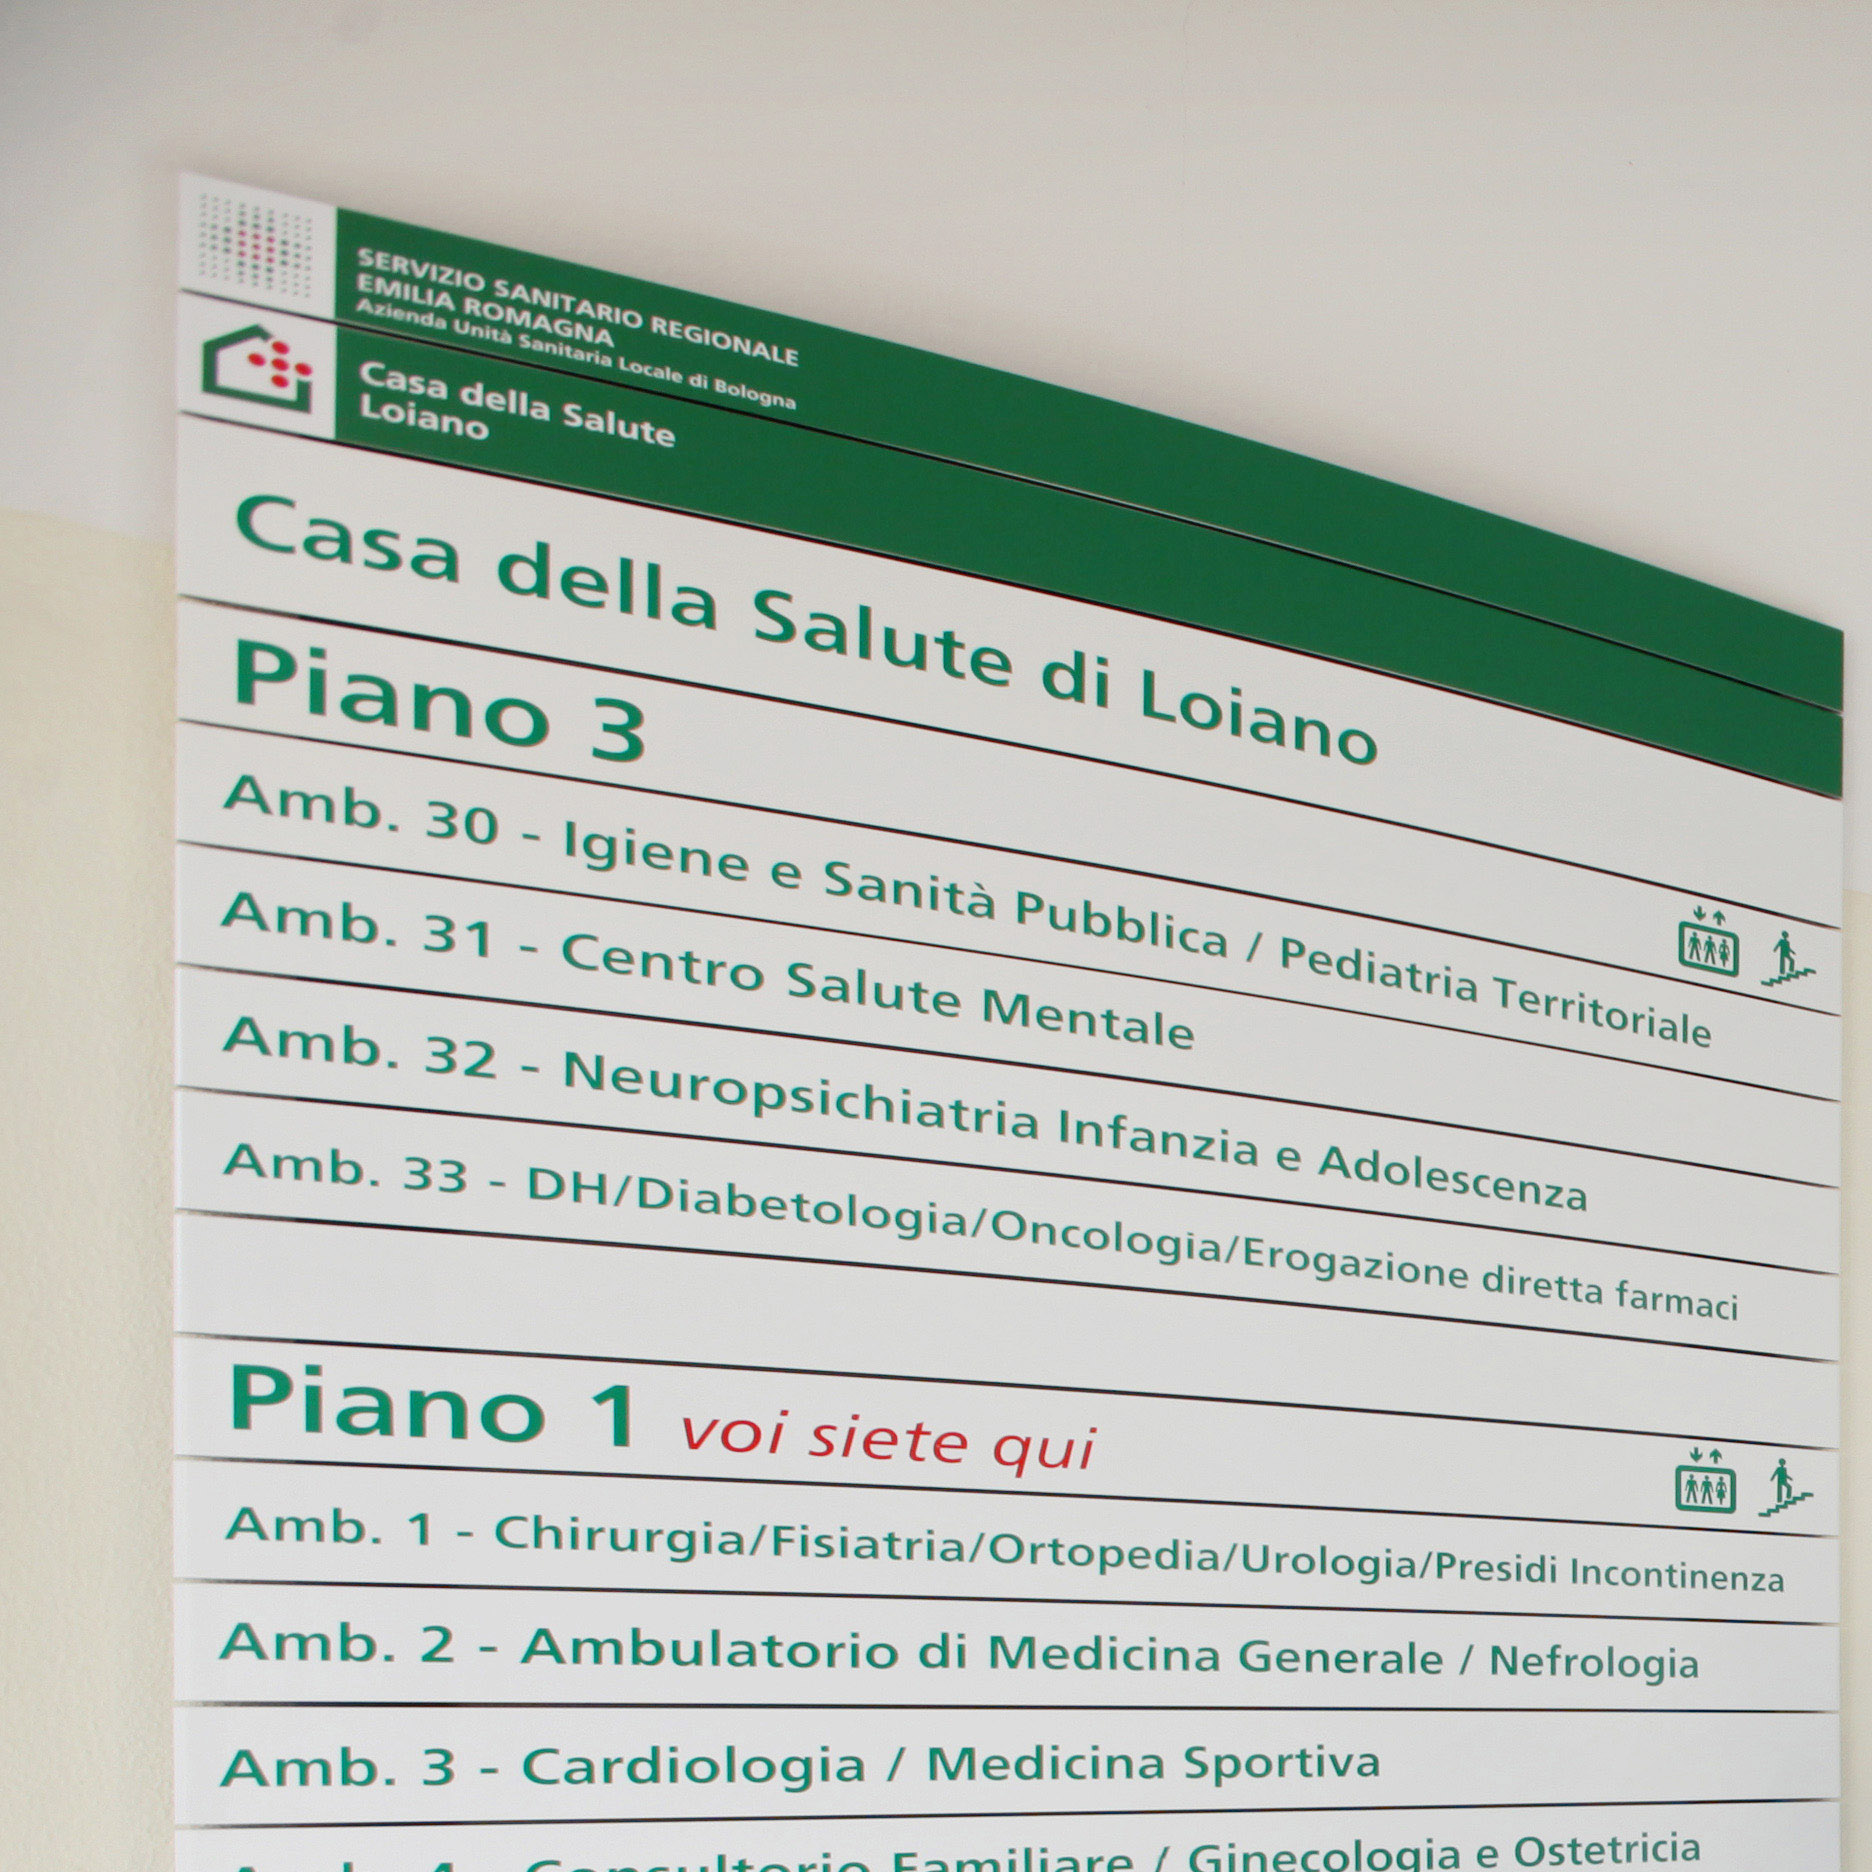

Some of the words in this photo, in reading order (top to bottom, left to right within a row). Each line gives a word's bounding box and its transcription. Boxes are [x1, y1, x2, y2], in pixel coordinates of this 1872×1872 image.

[357, 298, 447, 334] Azienda
[455, 316, 512, 345] Unità
[518, 333, 610, 366] Sanitaria
[619, 354, 684, 384] Locale
[689, 372, 708, 391] di
[715, 376, 796, 410] Bologna
[359, 248, 486, 293] SERVIZIO
[495, 279, 644, 329] SANITARIO
[652, 313, 798, 367] REGIONALE
[359, 274, 455, 314] EMILIA
[464, 298, 614, 348] ROMAGNA
[360, 360, 447, 402] Casa
[460, 380, 551, 421] della
[563, 402, 676, 448] Salute
[360, 393, 489, 440] Loiano
[233, 493, 457, 582] Casa
[495, 539, 714, 629] della
[752, 587, 1010, 686] Salute
[1039, 647, 1107, 707] di
[1141, 667, 1377, 764] Loiano
[233, 637, 548, 746] Piano
[590, 696, 646, 765] 3
[218, 773, 397, 831] Amb.
[423, 798, 496, 844] 30
[562, 819, 747, 881] Igiene
[768, 860, 800, 888] e
[822, 859, 993, 918] Sanità
[1013, 889, 1226, 967] Pubblica
[1279, 935, 1479, 1004] Pediatria
[1491, 975, 1711, 1047] Territoriale
[220, 1141, 377, 1186] Amb.
[401, 1155, 464, 1193] 33
[526, 1165, 1467, 1290] DH/Diabetologia/Oncologia/Erogazione
[1481, 1263, 1602, 1303] diretta
[1614, 1278, 1738, 1320] farmaci
[229, 1362, 543, 1443] Piano
[588, 1383, 628, 1447] 1
[683, 1409, 789, 1454] voi
[809, 1413, 968, 1464] siete
[994, 1427, 1098, 1479] qui
[222, 1505, 379, 1545] Amb.
[405, 1511, 426, 1546] 1
[493, 1513, 1556, 1585] Chirurgia/Fisiatria/Ortopedia/Urologia/Presidi
[1569, 1557, 1784, 1595] Incontinenza
